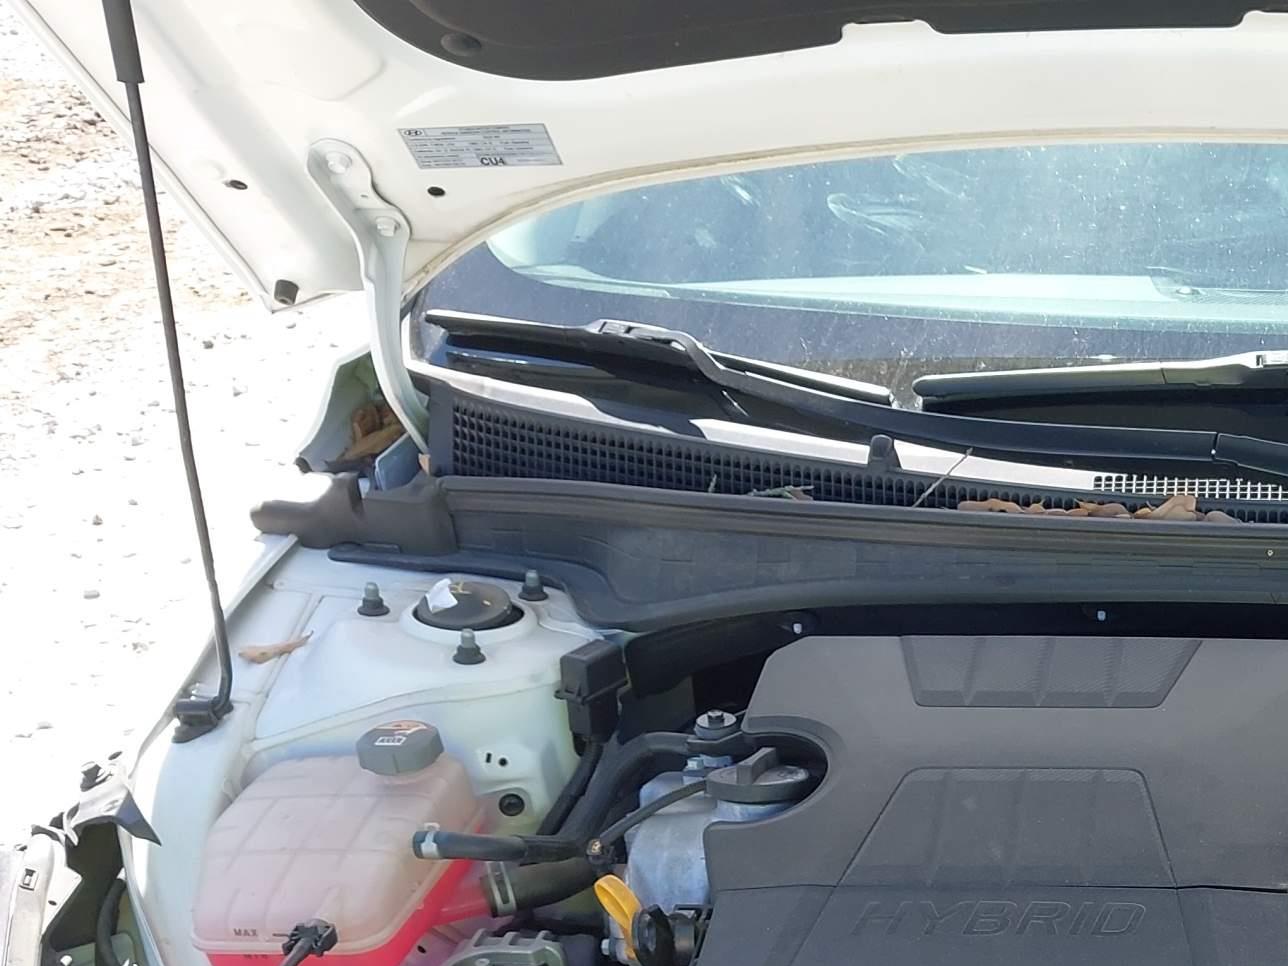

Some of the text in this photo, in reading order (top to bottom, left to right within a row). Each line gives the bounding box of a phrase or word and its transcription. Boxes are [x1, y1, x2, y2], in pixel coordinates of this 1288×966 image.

[480, 157, 506, 166] CU4
[851, 900, 1147, 936] HYBRID
[233, 928, 258, 937] MAX
